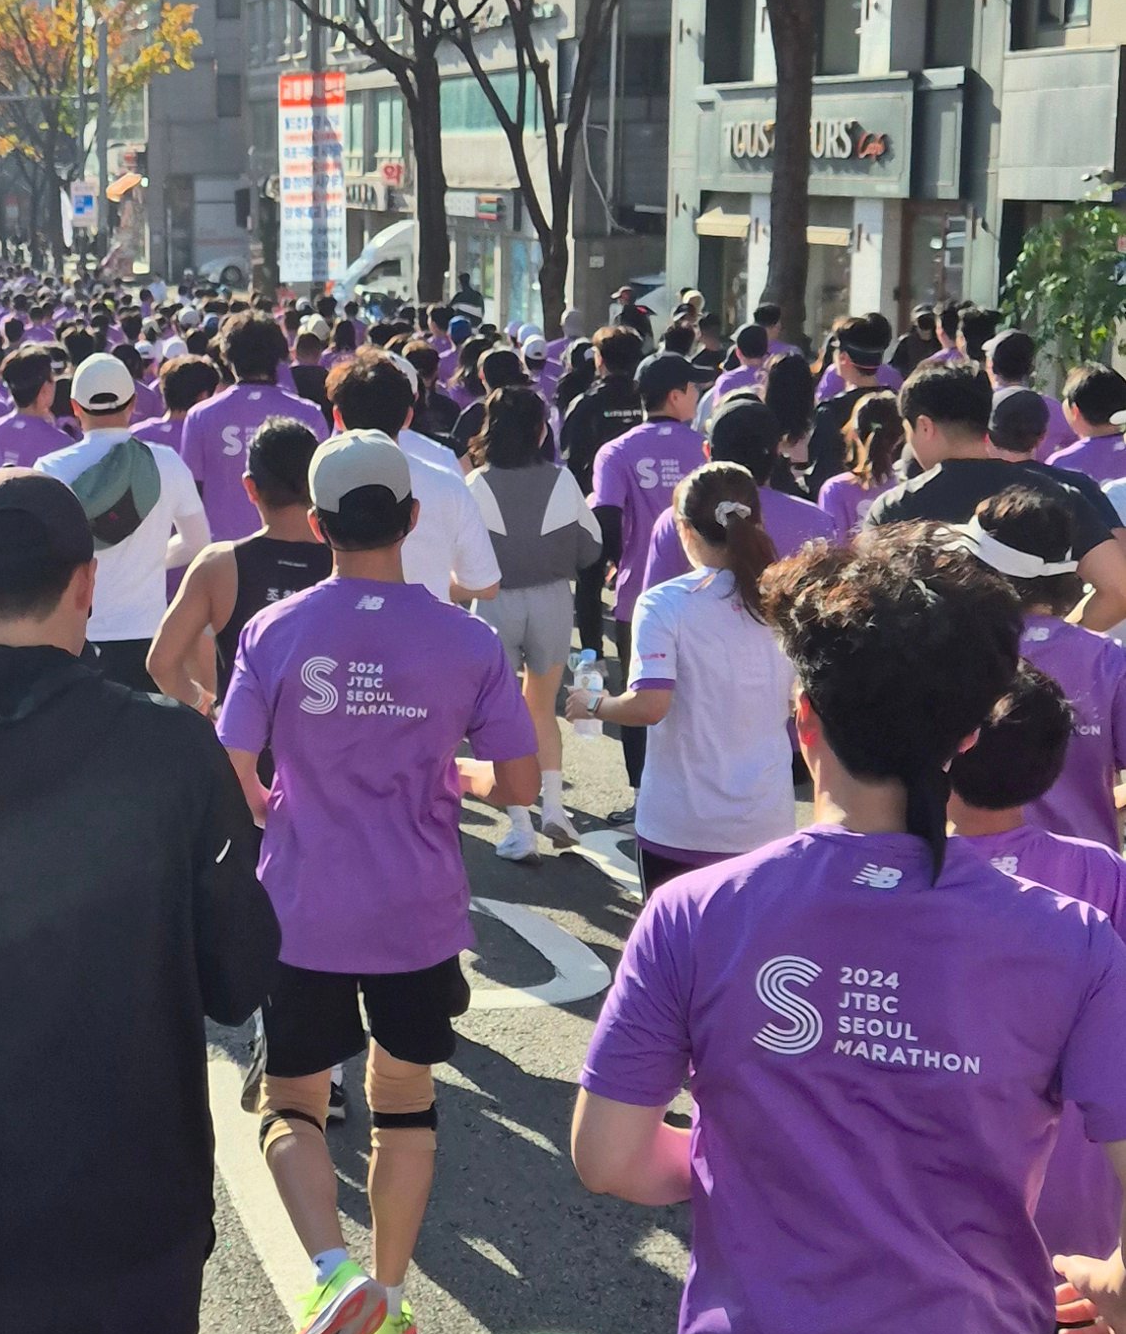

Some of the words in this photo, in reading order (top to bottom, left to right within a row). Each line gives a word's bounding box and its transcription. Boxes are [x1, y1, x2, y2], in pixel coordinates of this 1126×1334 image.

[723, 121, 770, 158] TOUS
[347, 662, 384, 674] 2024
[346, 676, 383, 688] JTBC
[346, 690, 394, 702] SEOUL
[345, 704, 428, 718] MARATHON
[839, 966, 900, 989] 2024
[838, 991, 899, 1014] JTBC
[838, 1016, 919, 1041] SEOUL
[833, 1039, 981, 1074] MARATHON
